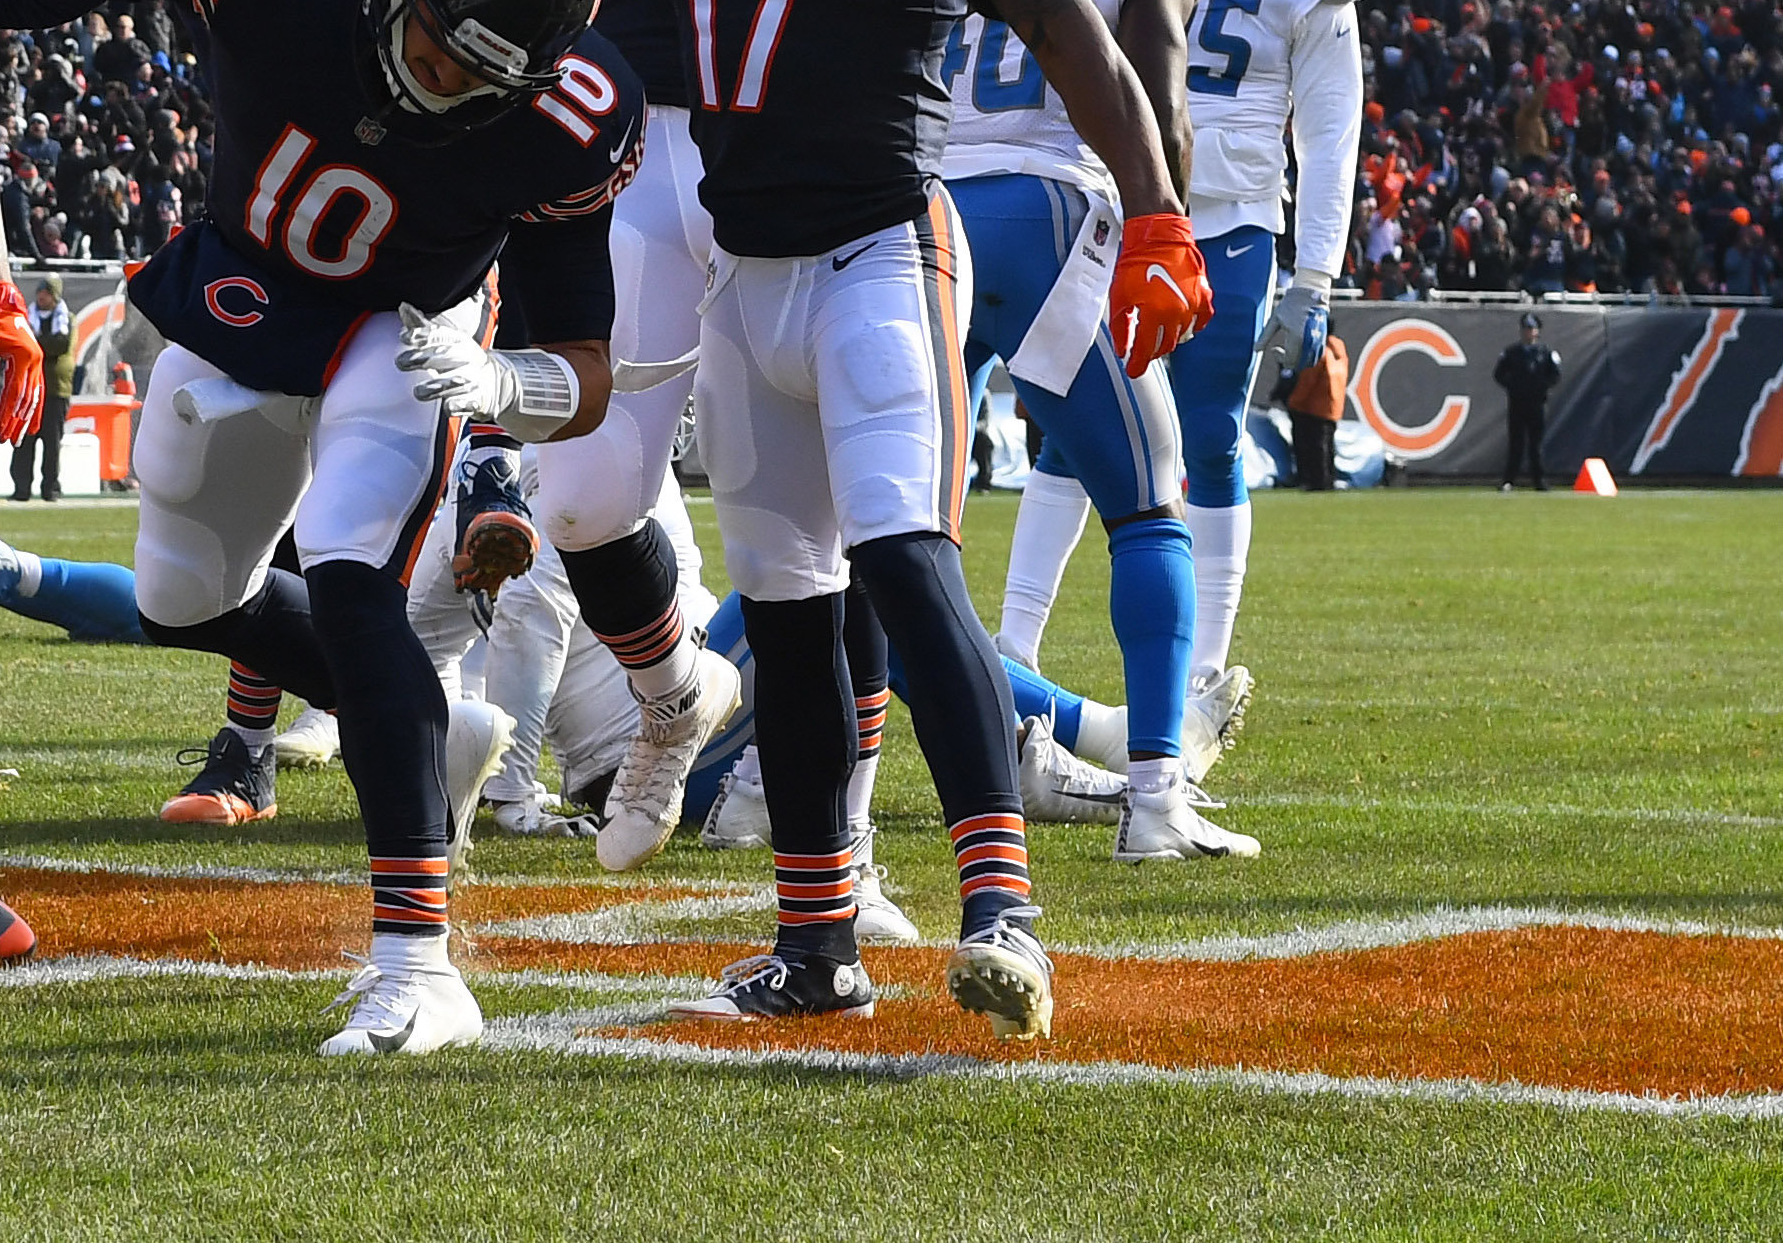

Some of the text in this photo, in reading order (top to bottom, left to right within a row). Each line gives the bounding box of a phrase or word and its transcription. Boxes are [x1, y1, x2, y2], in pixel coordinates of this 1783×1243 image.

[531, 53, 618, 147] 10
[243, 121, 399, 280] 10
[677, 681, 702, 715] NIKE
